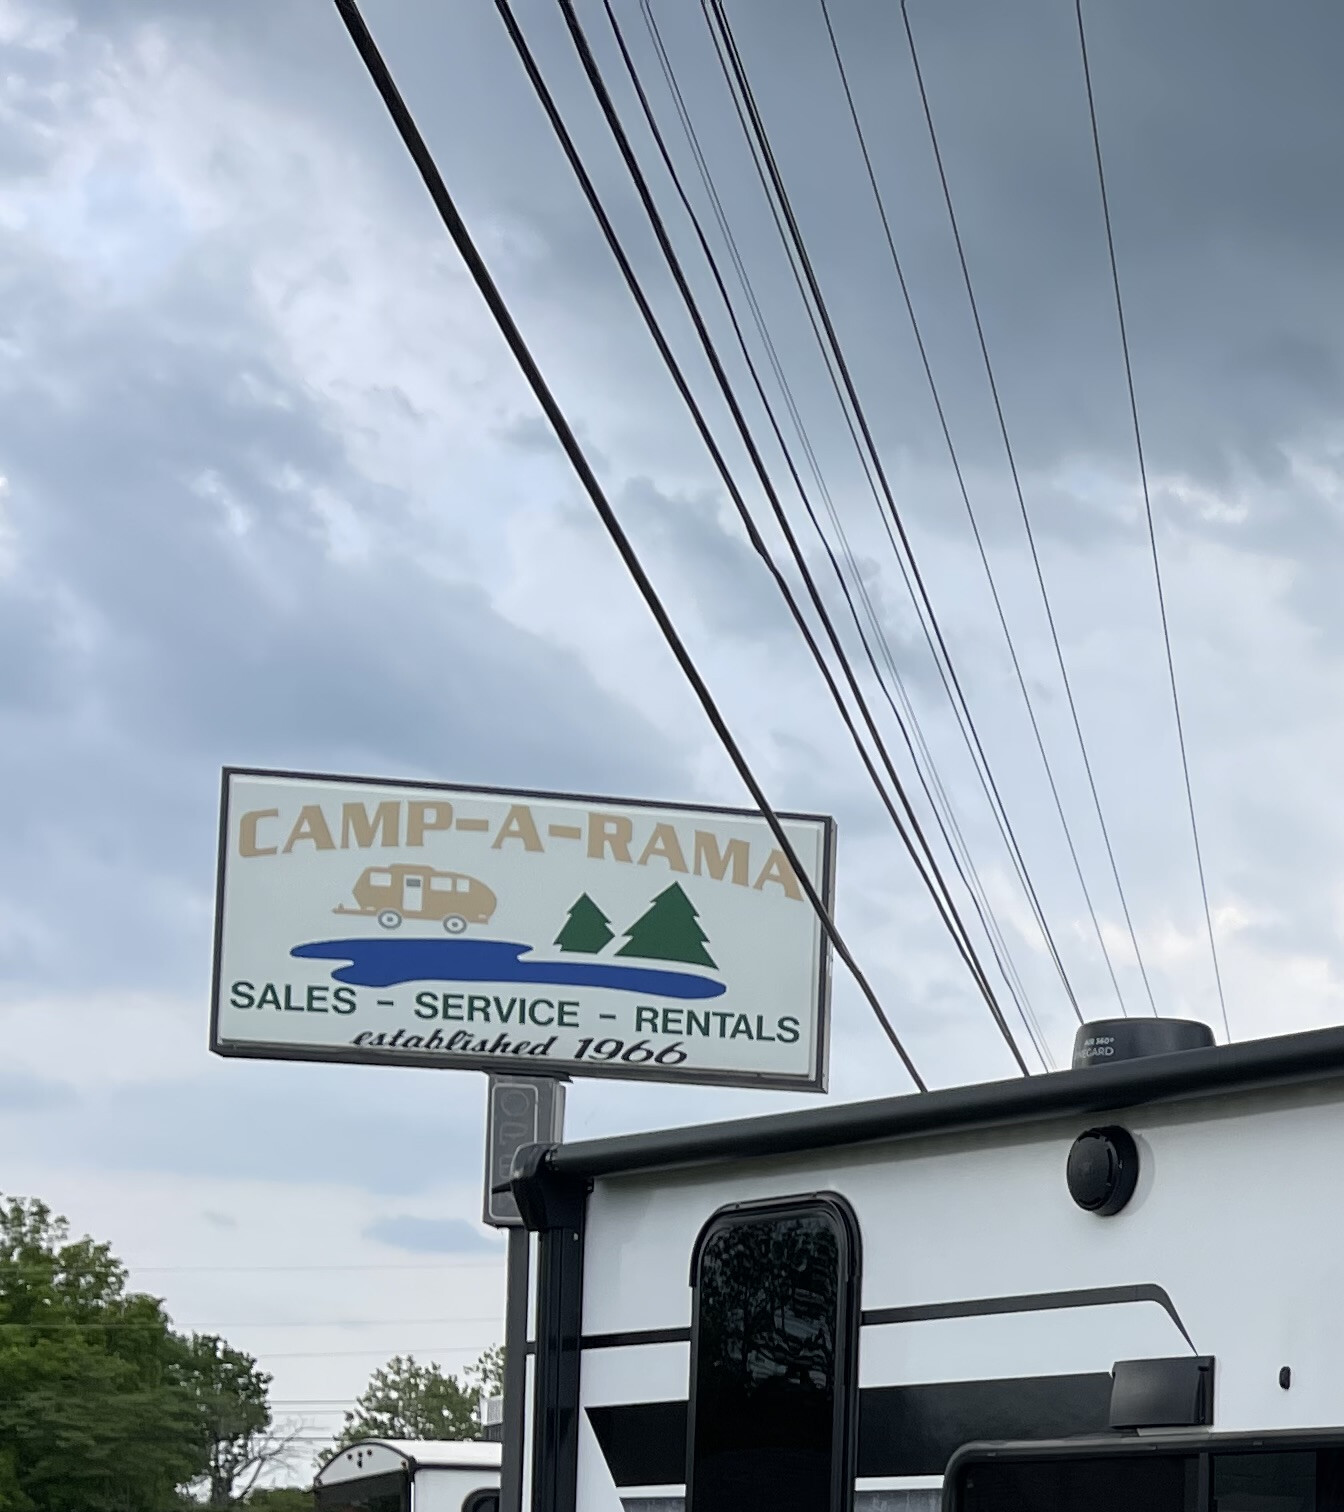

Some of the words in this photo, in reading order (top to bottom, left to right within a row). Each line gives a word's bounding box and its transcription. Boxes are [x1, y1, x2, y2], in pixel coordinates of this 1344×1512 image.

[238, 801, 805, 902] CAMP-A-RAMA
[230, 981, 357, 1015] SALES
[414, 991, 580, 1027] SERVICE
[635, 1005, 801, 1043] RENTALS
[352, 1028, 558, 1057] established
[573, 1037, 688, 1065] 1966
